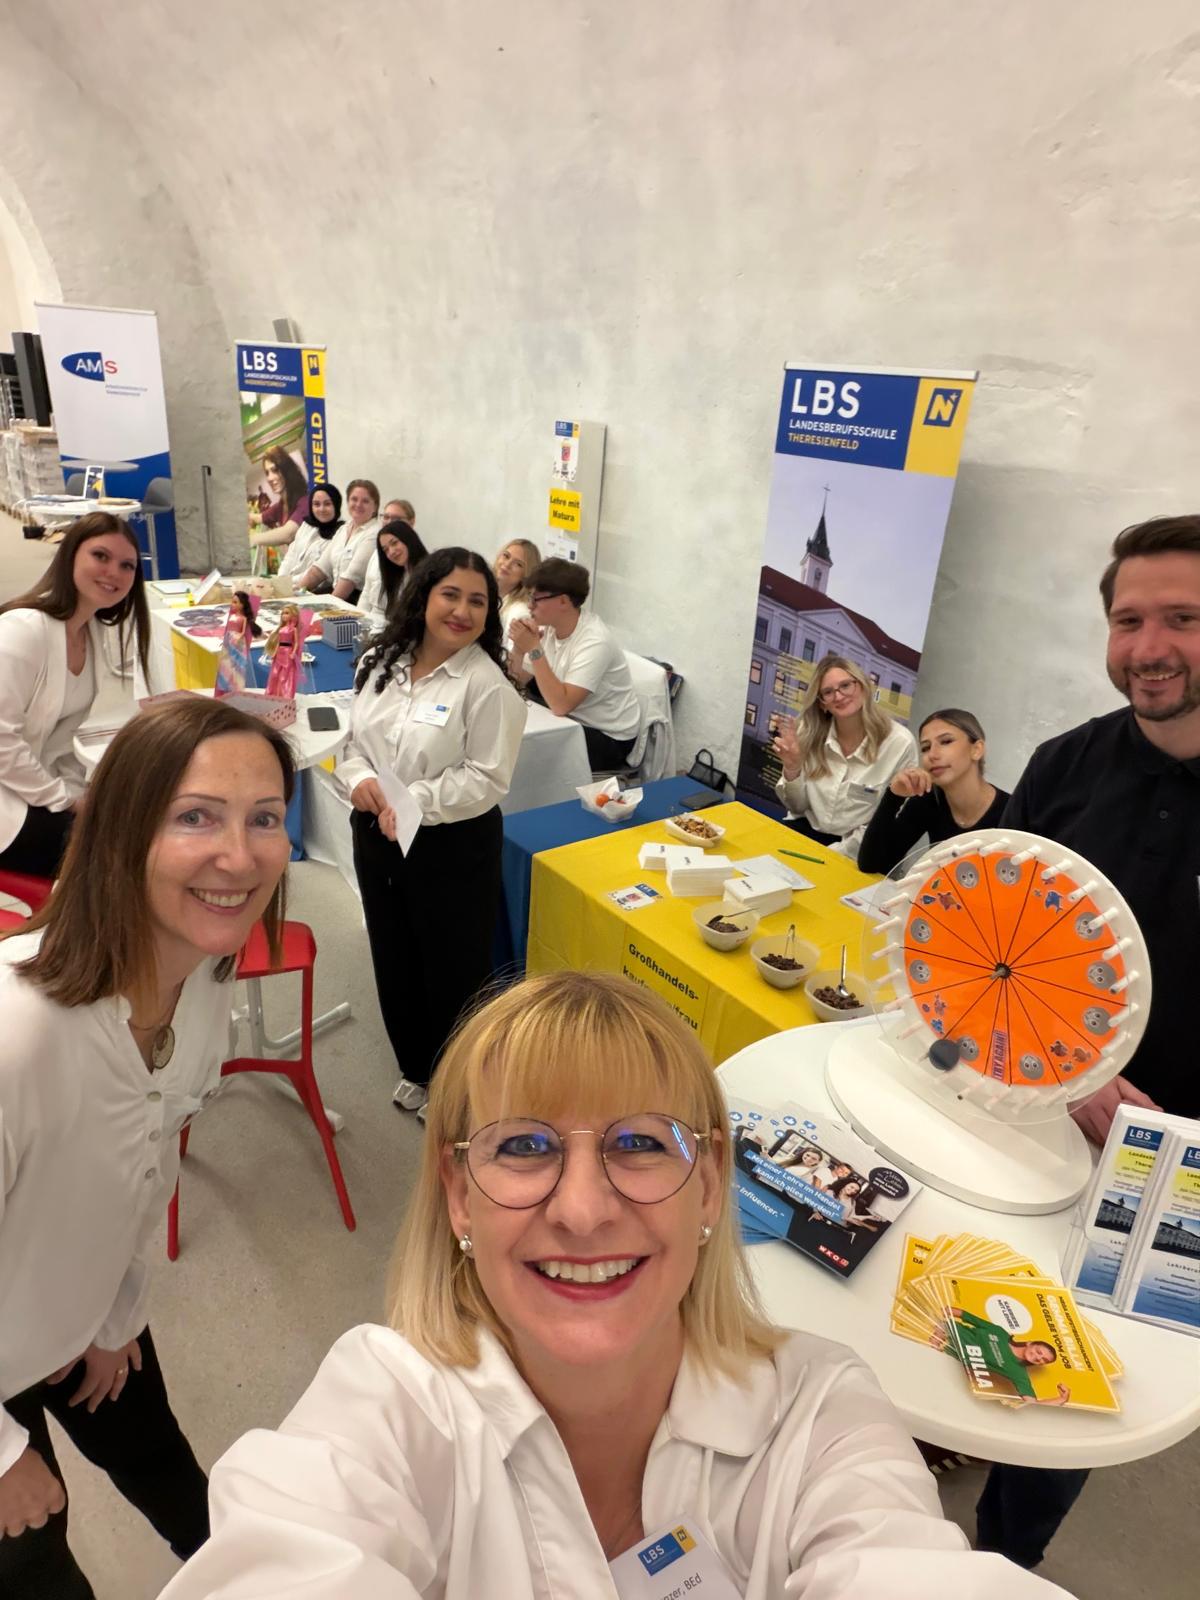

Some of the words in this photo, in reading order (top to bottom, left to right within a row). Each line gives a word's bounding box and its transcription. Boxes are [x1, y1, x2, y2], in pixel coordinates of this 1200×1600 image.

[75, 358, 117, 374] AMS
[242, 351, 278, 372] LBS
[792, 379, 861, 418] LBS
[789, 419, 897, 440] LANDESBERUFSSCHULE
[311, 412, 325, 486] NFELD
[788, 433, 859, 450] THERESIENFELD
[550, 496, 566, 507] Lehre
[568, 500, 579, 508] mit
[552, 510, 574, 522] Matura
[628, 943, 699, 1001] Großhandels-
[1129, 1129, 1152, 1140] LBS
[755, 1167, 775, 1181] kann
[774, 1177, 786, 1188] ich
[785, 1184, 804, 1199] alles
[763, 1162, 782, 1176] einer
[782, 1172, 805, 1189] Lehre
[803, 1184, 815, 1194] im
[813, 1191, 842, 1211] Handel
[1036, 1294, 1047, 1307] DAS
[1042, 1309, 1057, 1332] GELBE
[1053, 1334, 1064, 1352] VOM
[1059, 1354, 1072, 1369] JOB
[965, 1344, 993, 1389] BILLA
[643, 1545, 664, 1563] LBS
[684, 1573, 702, 1590] BEd
